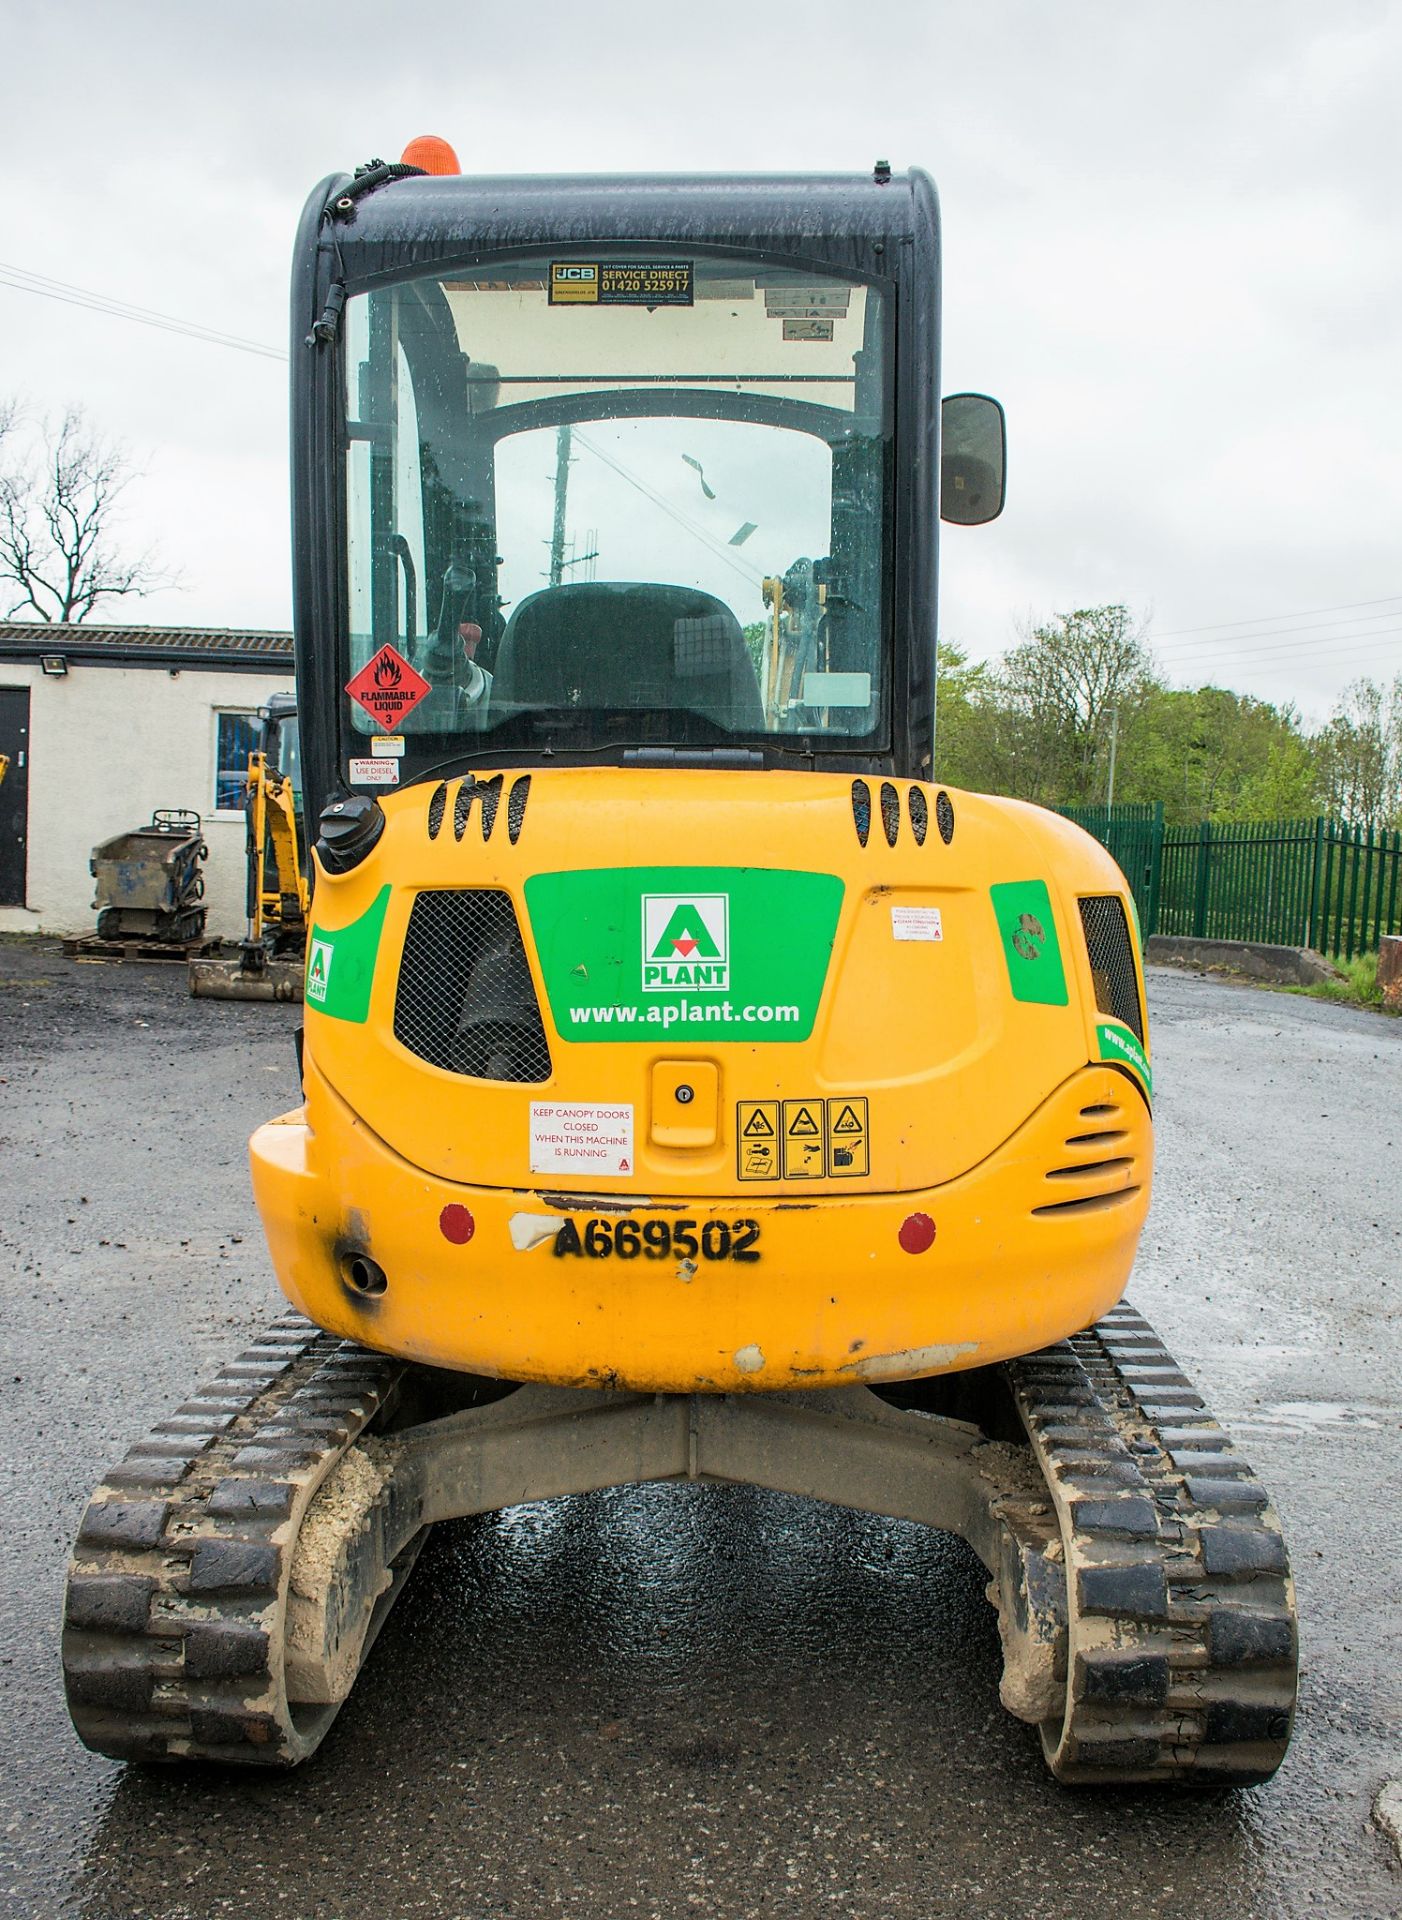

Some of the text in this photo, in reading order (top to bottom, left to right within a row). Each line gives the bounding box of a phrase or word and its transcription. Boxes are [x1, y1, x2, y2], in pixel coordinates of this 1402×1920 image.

[556, 268, 594, 279] JCB
[602, 271, 689, 280] SERVICE DIRECT
[602, 280, 640, 290] 01420
[644, 280, 689, 290] 525917
[361, 692, 416, 701] FLAMMABLE
[374, 702, 402, 711] LIQUID
[386, 714, 392, 724] 3
[651, 904, 722, 958] A
[310, 947, 326, 982] A
[644, 966, 726, 985] PLANT
[308, 980, 326, 998] PLANT
[570, 1000, 800, 1028] www.aplant.com
[533, 1108, 630, 1119] KEEP CANOPY DOORS
[563, 1123, 598, 1131] CLOSED
[535, 1134, 563, 1143] WHEN
[586, 1137, 628, 1145] MACHINE
[564, 1148, 607, 1157] RUNNING
[553, 1217, 762, 1262] A669502
